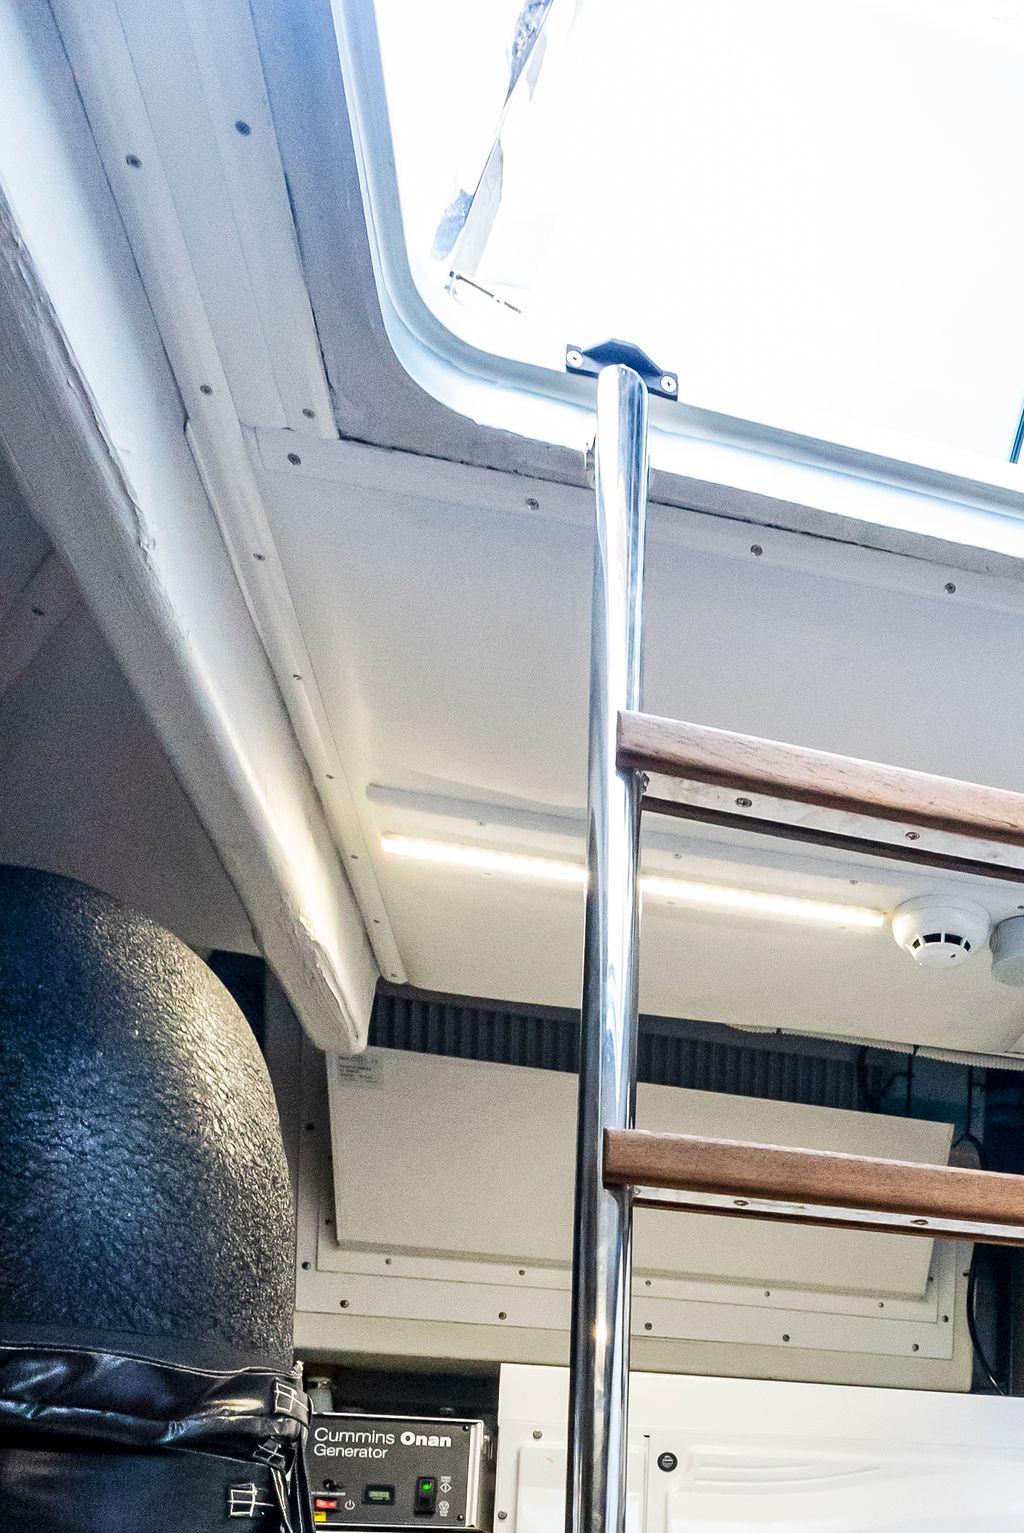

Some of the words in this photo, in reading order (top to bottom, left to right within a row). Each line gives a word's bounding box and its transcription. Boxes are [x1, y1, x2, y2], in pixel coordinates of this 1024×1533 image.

[314, 1427, 395, 1445] Cummins
[400, 1431, 452, 1448] Onan
[313, 1444, 388, 1459] Generator
